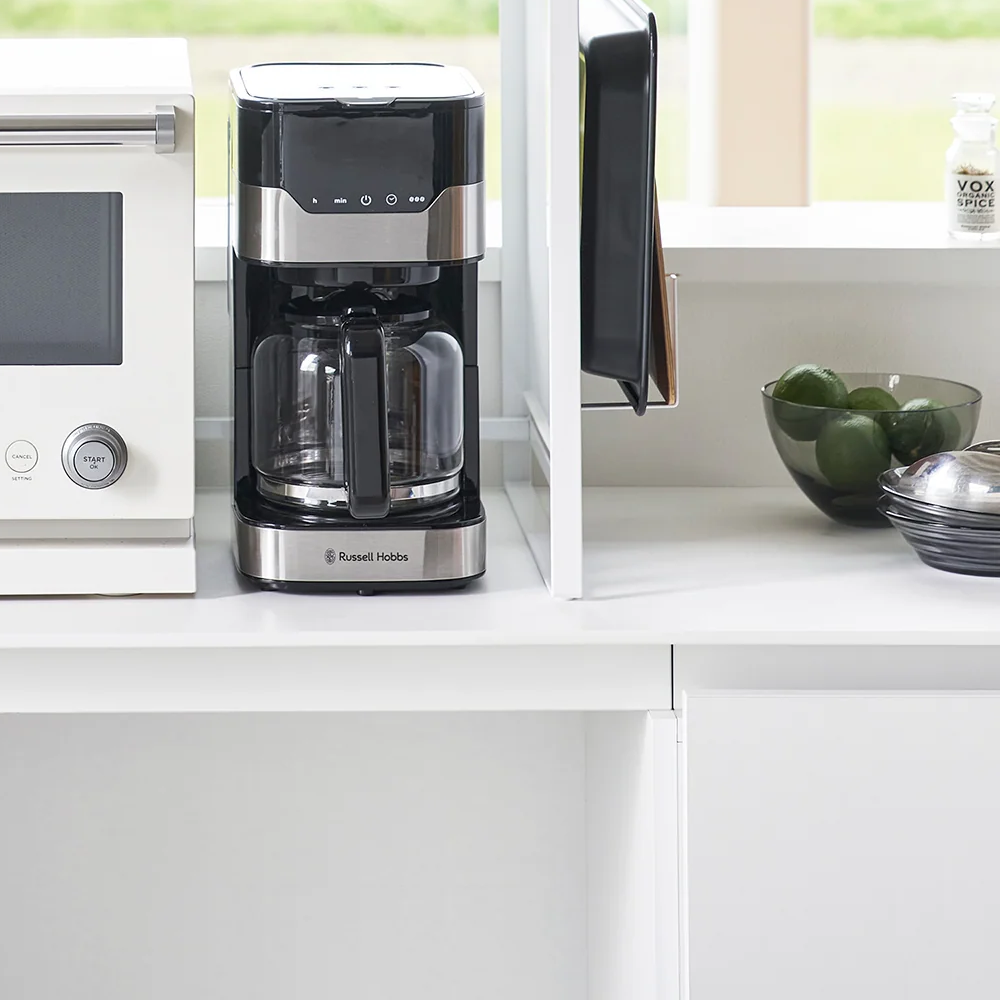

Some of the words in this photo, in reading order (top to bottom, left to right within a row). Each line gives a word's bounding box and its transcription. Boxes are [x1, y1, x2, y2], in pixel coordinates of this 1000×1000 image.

[957, 179, 995, 193] VOX
[956, 198, 995, 208] SPICE
[82, 455, 106, 463] START
[338, 551, 374, 562] Russell
[376, 551, 409, 562] Hobbs
